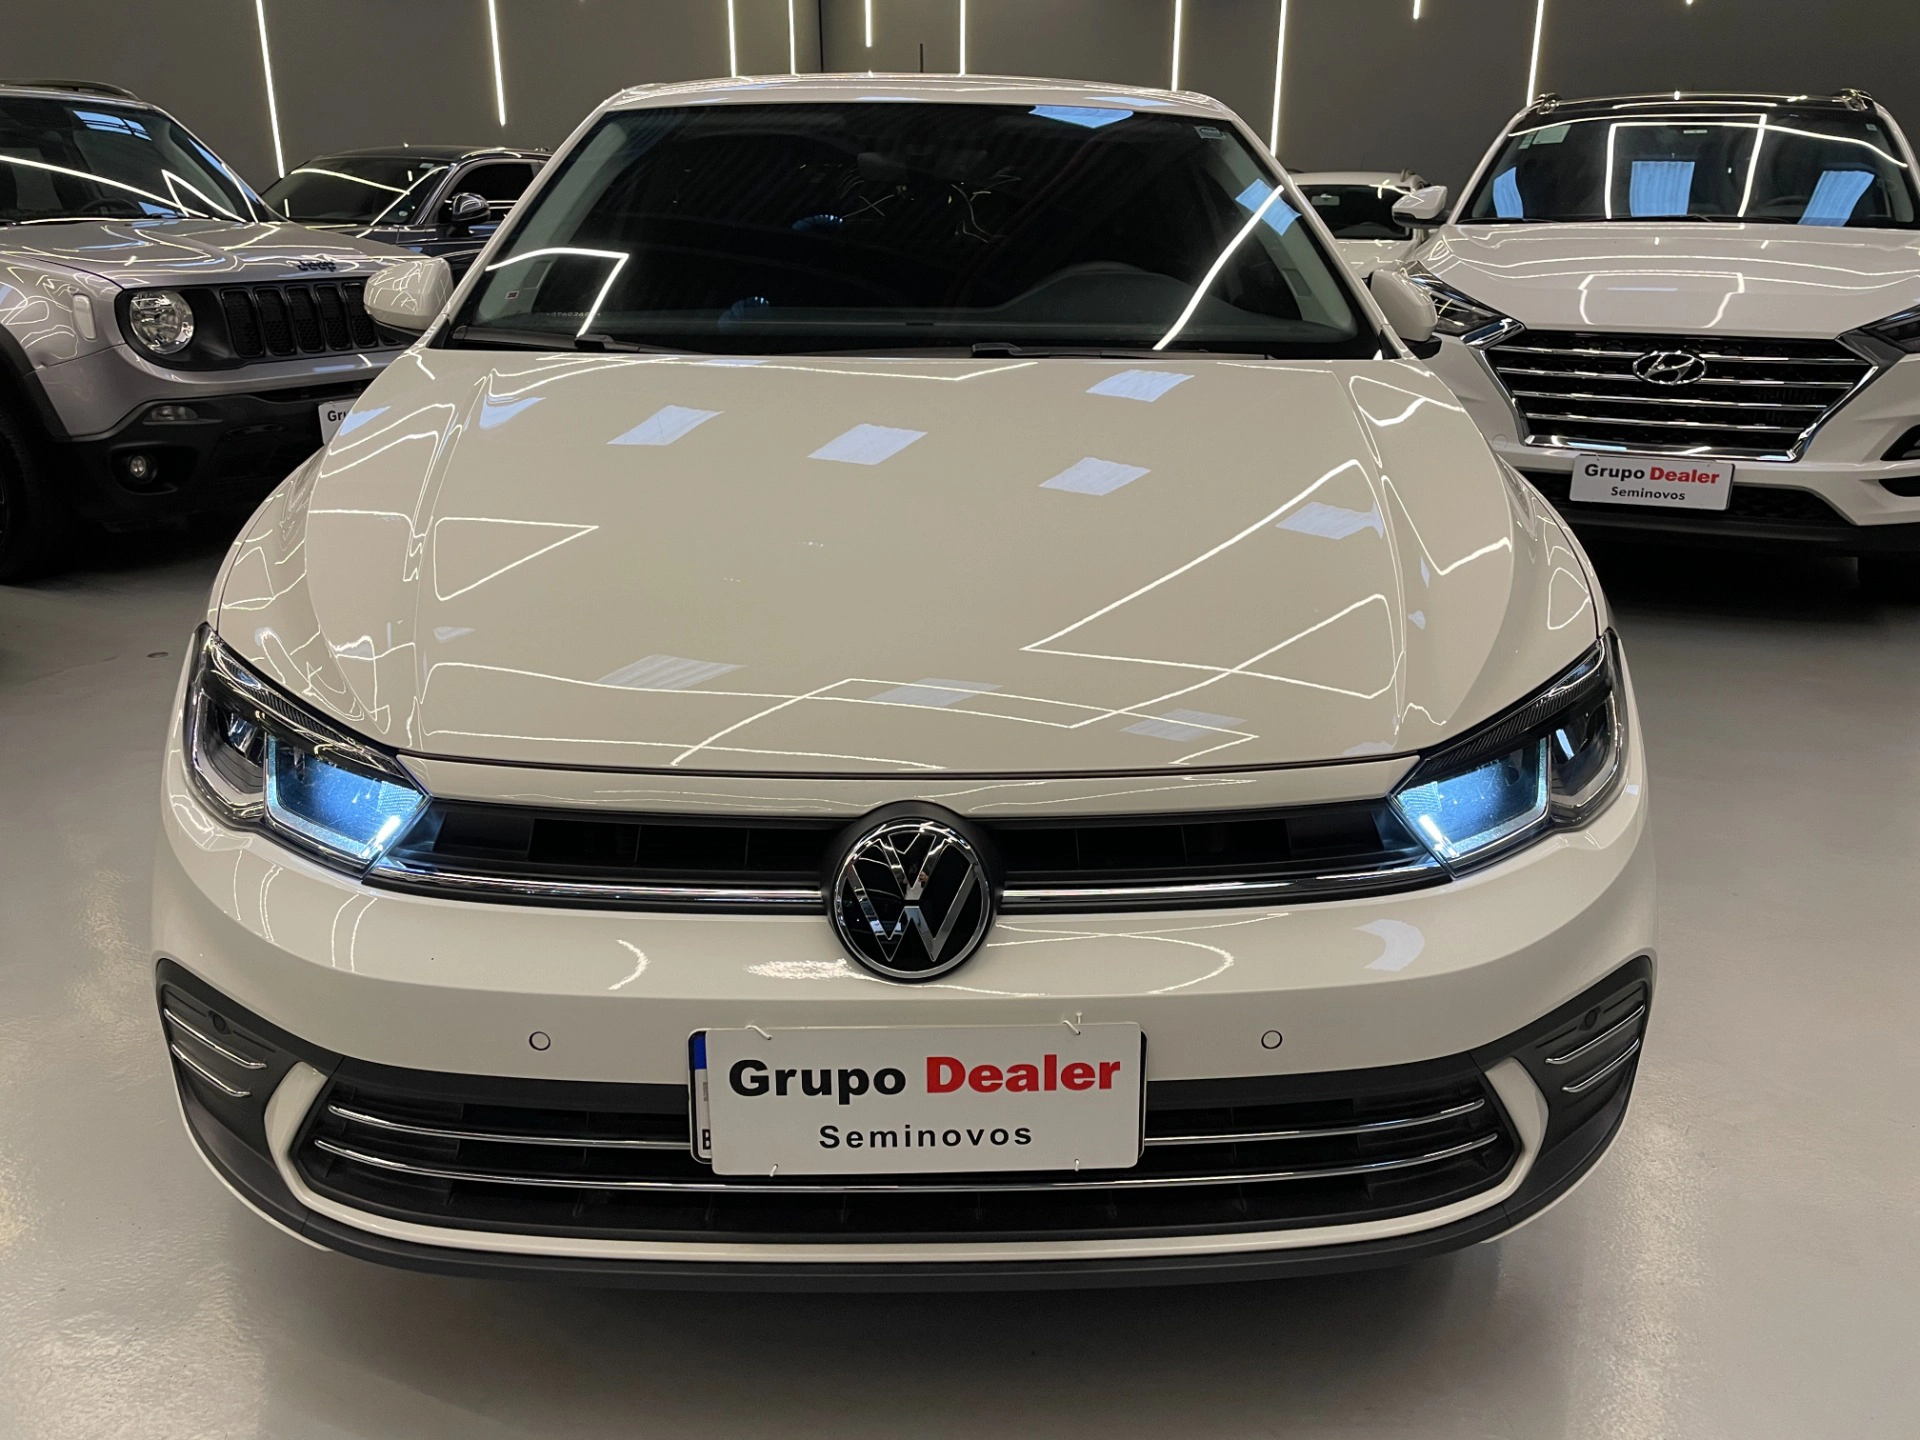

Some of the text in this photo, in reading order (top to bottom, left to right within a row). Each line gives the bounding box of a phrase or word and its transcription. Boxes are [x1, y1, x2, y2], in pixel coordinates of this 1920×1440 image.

[1584, 463, 1720, 484] Grupo Dealer
[1610, 486, 1686, 501] Seminovos
[728, 1059, 907, 1105] Grupo
[926, 1054, 1121, 1093] Dealer
[819, 1125, 1033, 1149] Seminovos
